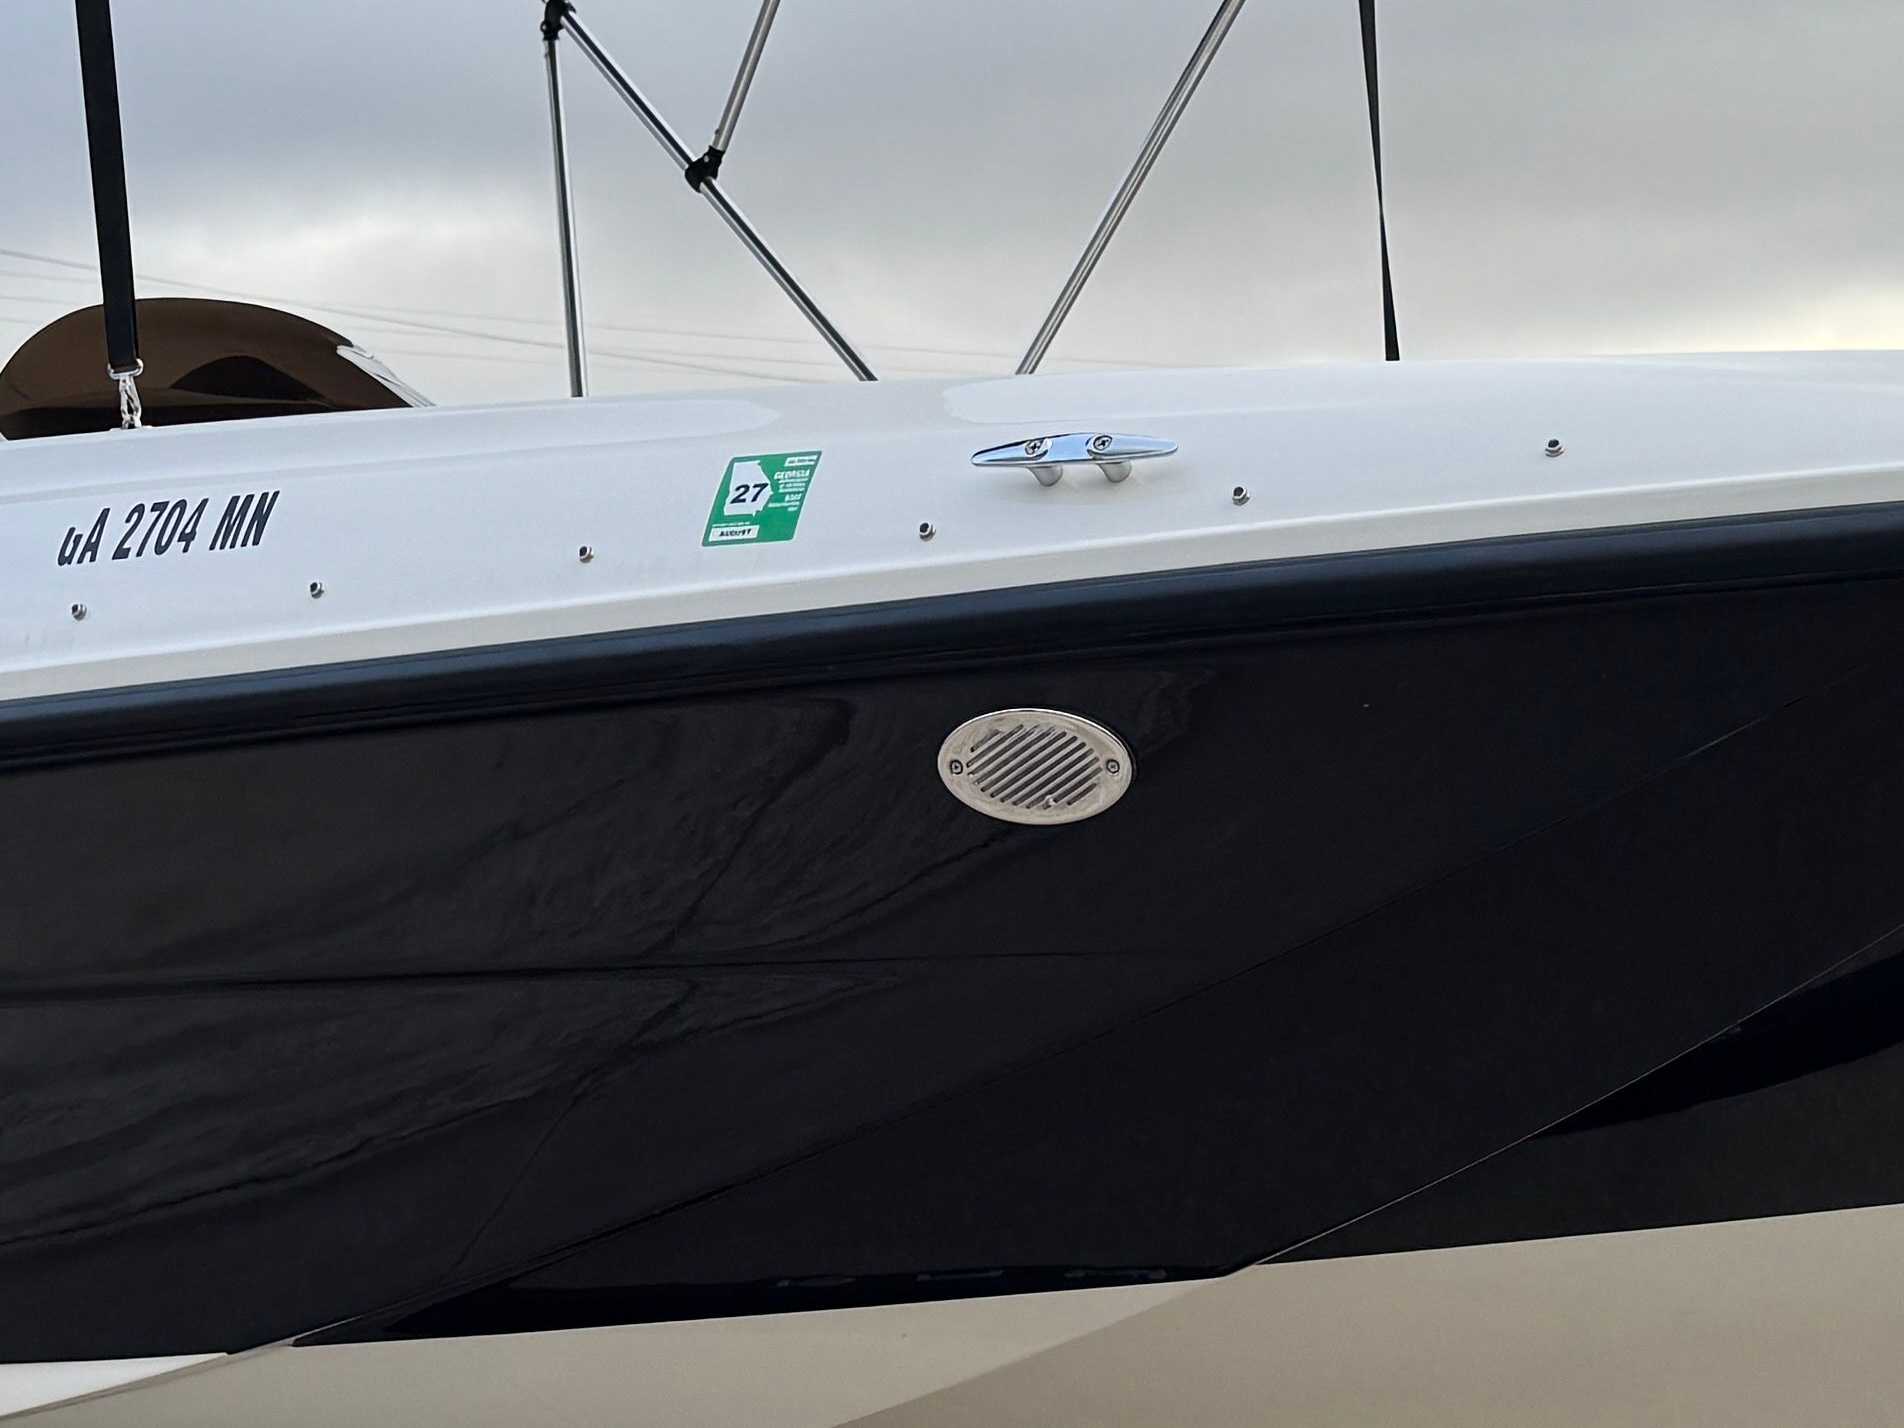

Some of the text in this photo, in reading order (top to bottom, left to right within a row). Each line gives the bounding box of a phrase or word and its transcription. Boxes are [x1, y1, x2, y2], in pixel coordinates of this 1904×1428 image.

[729, 482, 770, 504] 27
[111, 498, 209, 561] 2704
[208, 490, 280, 551] MN
